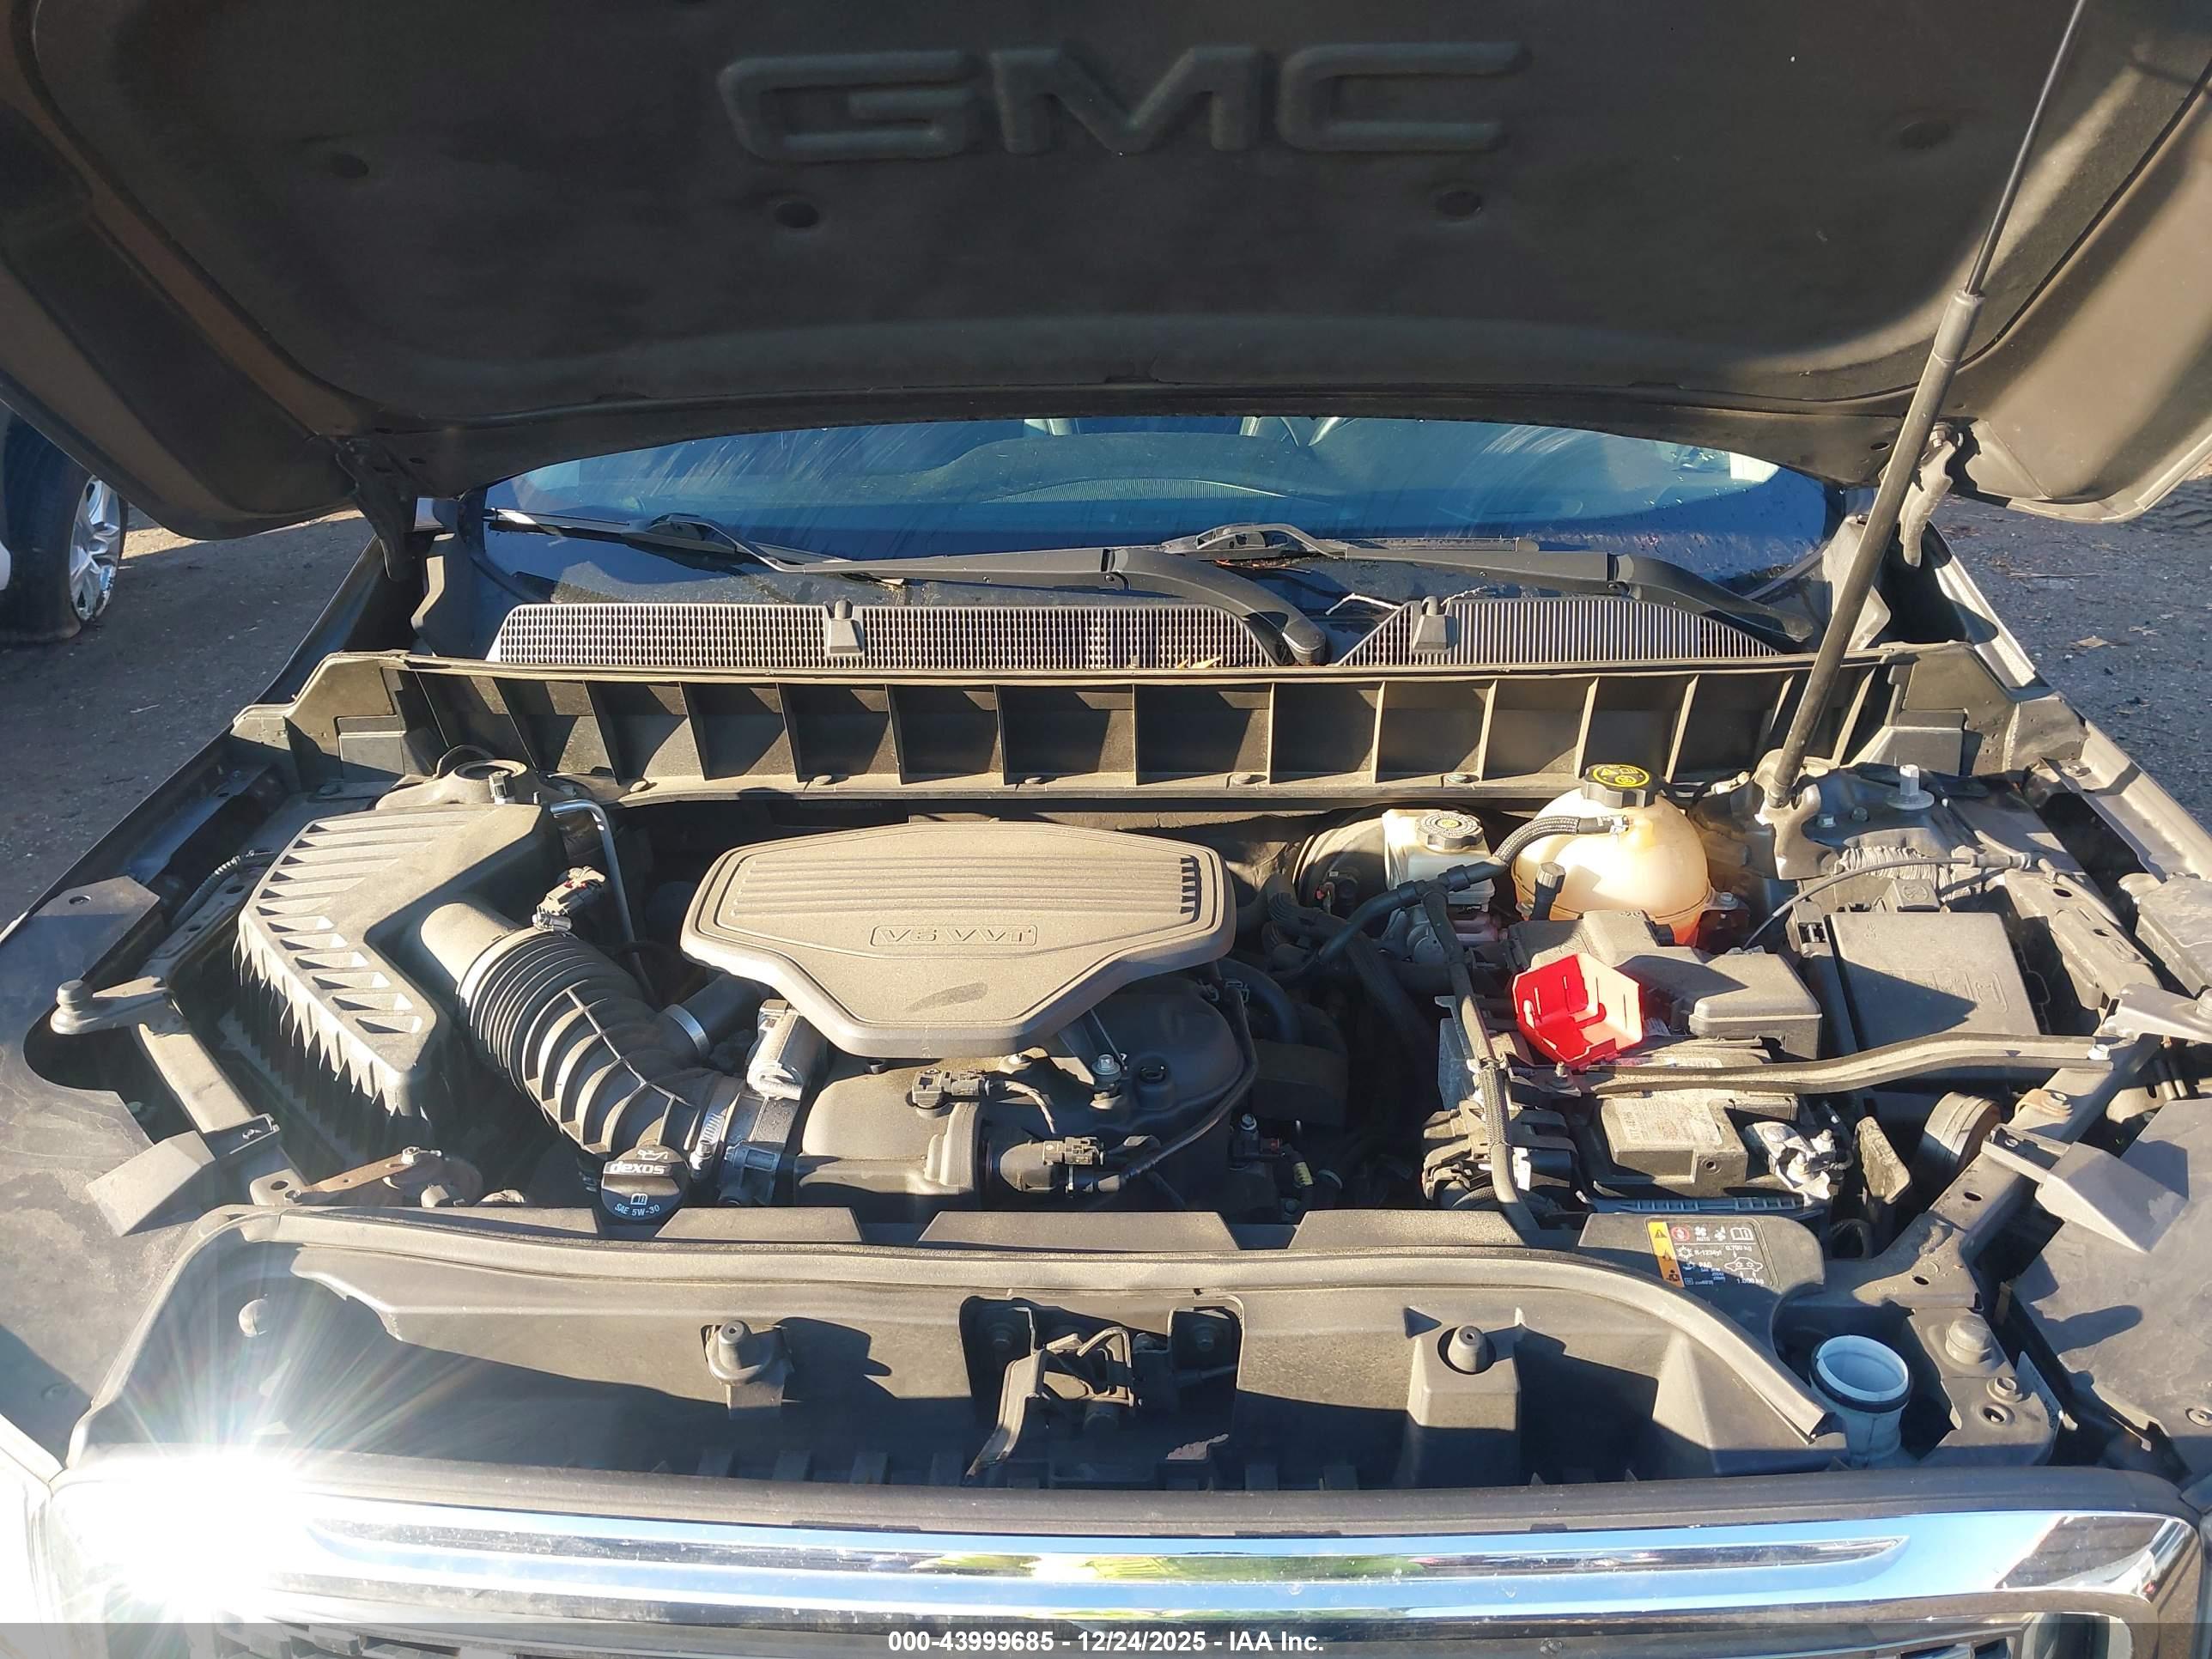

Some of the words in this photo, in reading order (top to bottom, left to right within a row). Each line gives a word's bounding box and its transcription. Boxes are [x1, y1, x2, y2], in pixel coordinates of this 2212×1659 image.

[718, 41, 1526, 161] GMC
[878, 927, 938, 942] V6
[946, 927, 1034, 942] VVT
[610, 1161, 665, 1175] dexos
[615, 1204, 629, 1215] SAE
[631, 1204, 660, 1216] 5W-30
